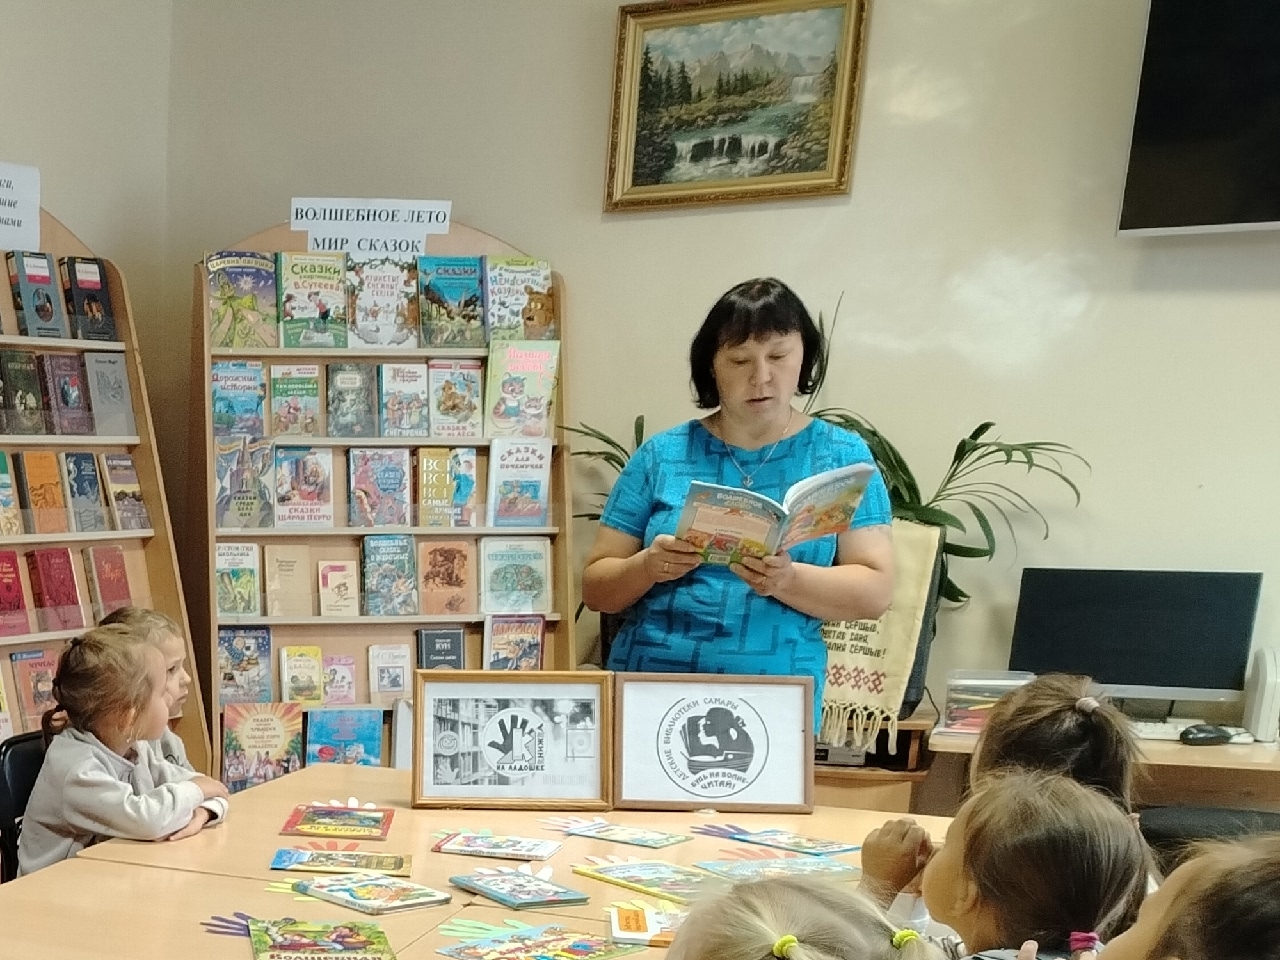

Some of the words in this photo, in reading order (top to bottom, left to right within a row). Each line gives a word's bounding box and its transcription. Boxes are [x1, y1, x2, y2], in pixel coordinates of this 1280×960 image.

[294, 206, 400, 224] ВОЛШЕБНОЕ
[404, 209, 448, 224] ЛЕТО
[311, 236, 350, 252] МИР
[356, 238, 423, 253] СКАЗОК
[291, 263, 341, 277] Сказки
[703, 697, 739, 711] САМАРЫ
[663, 699, 700, 745] БИБЛИОТЕКИ
[496, 764, 506, 772] НА
[664, 748, 690, 781] ДЕТСКИЕ
[690, 775, 709, 788] БУДЬ
[710, 772, 720, 780] НА
[701, 780, 736, 791] ЧИТАЙ!
